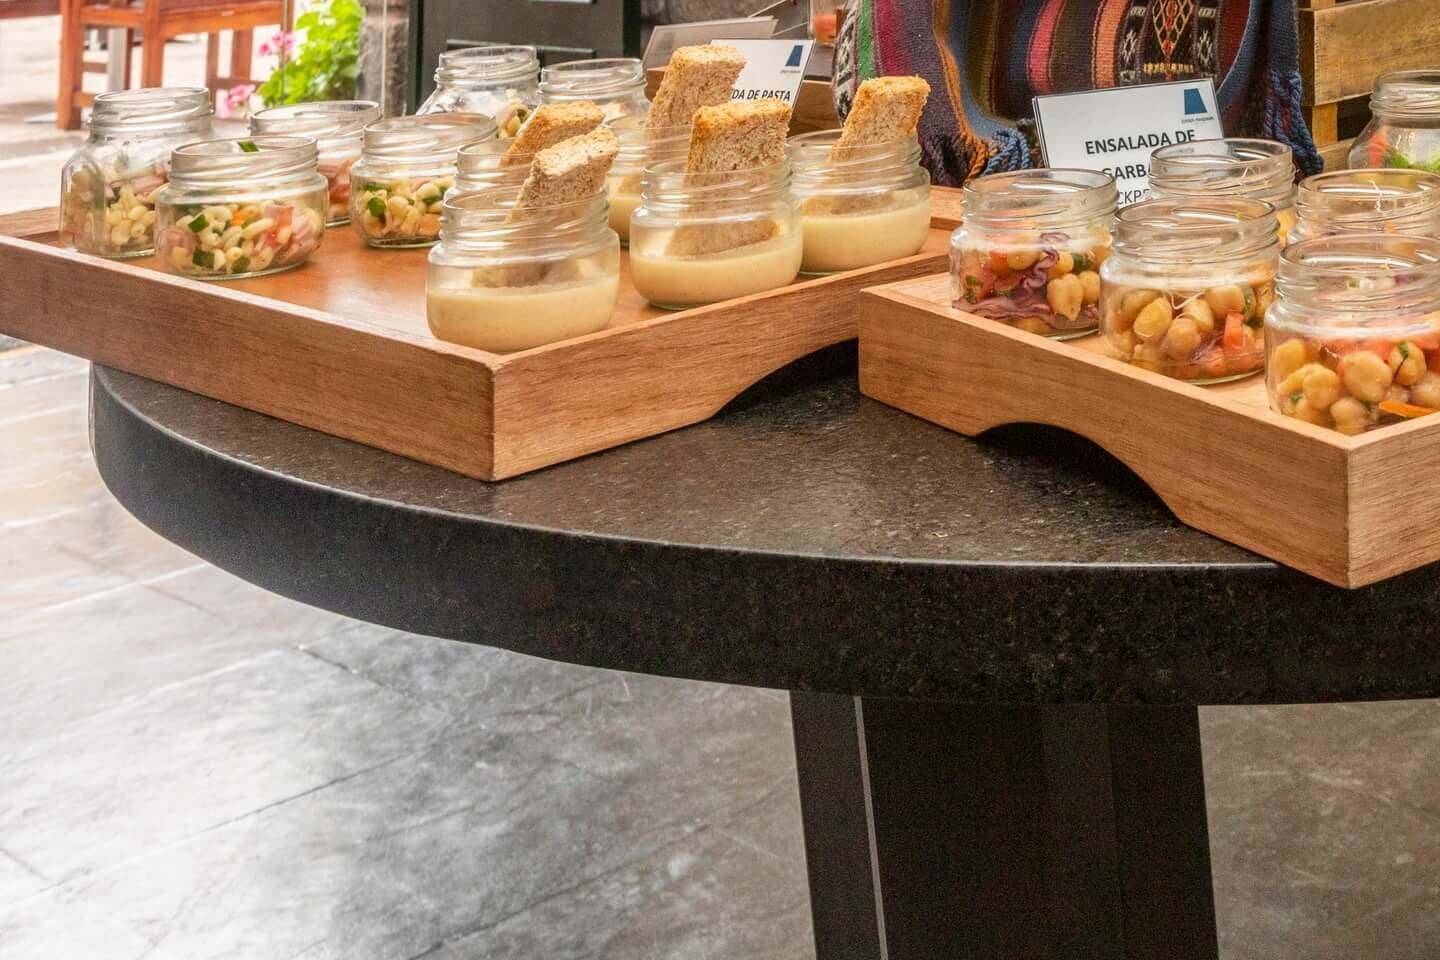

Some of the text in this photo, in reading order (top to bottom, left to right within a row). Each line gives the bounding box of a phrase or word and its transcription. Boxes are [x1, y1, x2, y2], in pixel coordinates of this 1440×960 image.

[748, 90, 761, 100] DE
[762, 90, 791, 101] PASTA
[1086, 132, 1172, 155] ENSALADA
